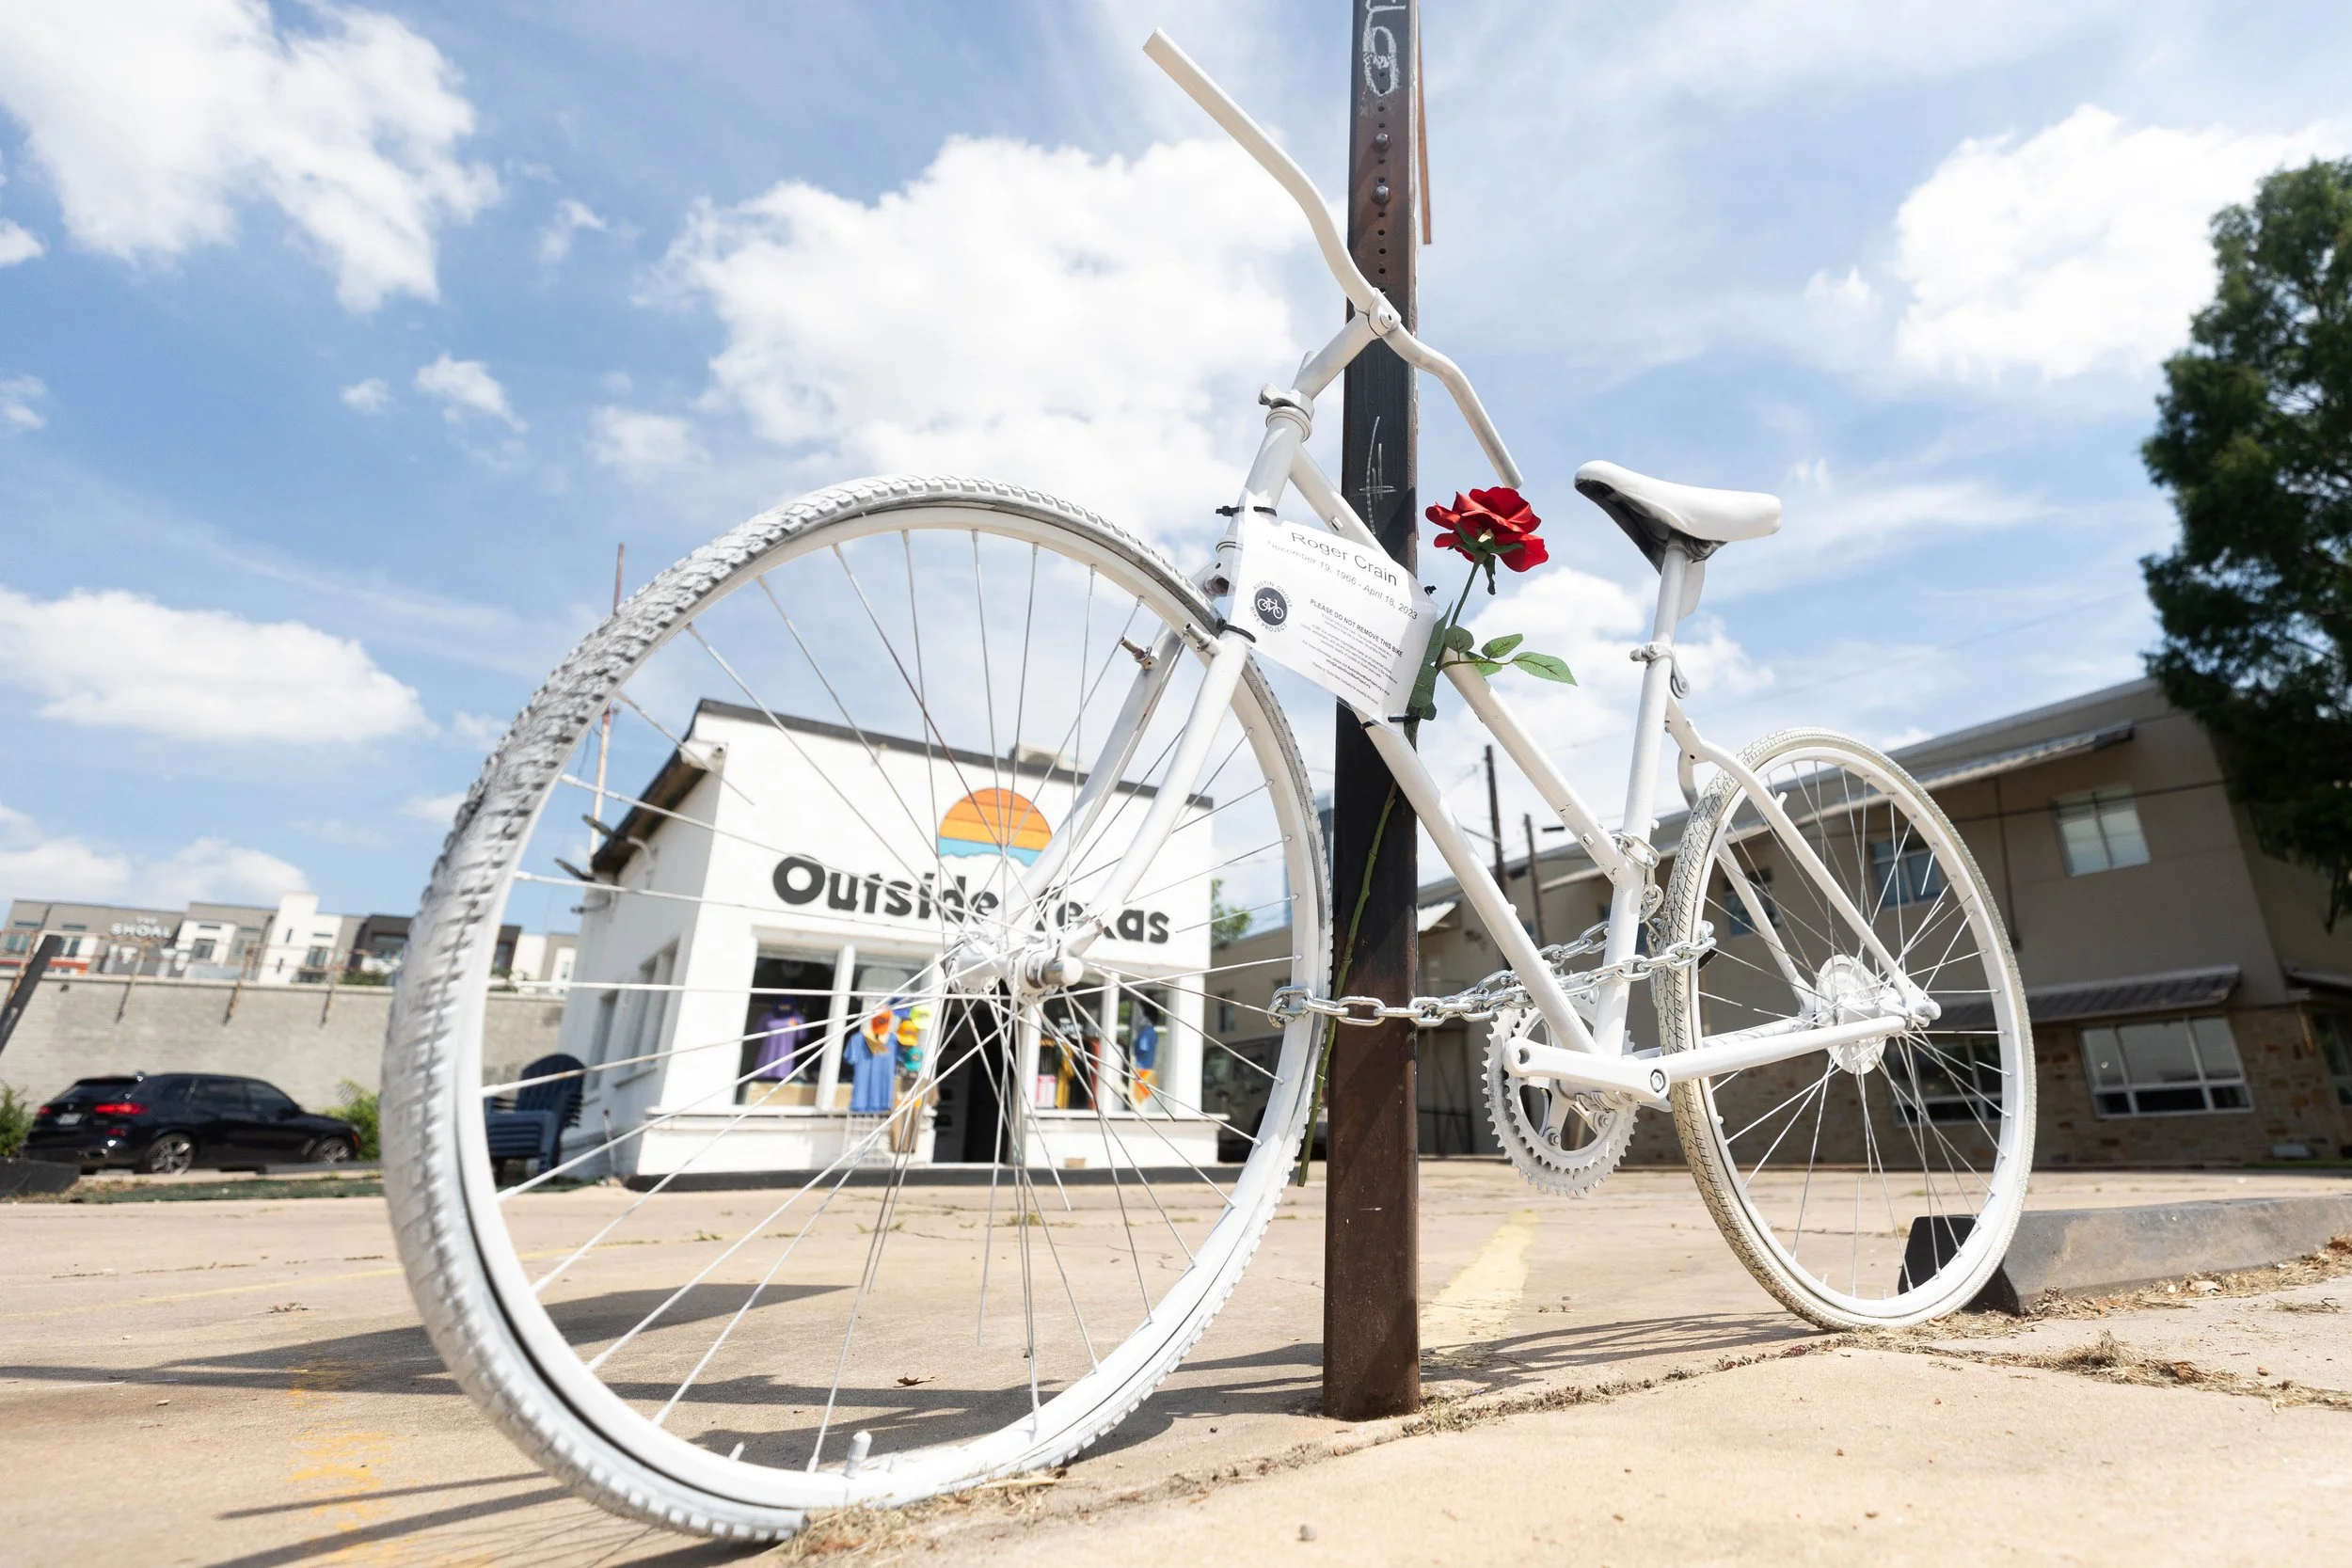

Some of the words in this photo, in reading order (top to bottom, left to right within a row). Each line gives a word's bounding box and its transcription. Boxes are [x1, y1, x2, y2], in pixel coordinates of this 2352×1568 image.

[1253, 580, 1275, 590] AUSTIN
[1292, 532, 1347, 560] Roger
[1355, 555, 1397, 586] Crain
[1337, 569, 1357, 585] 1966
[1363, 584, 1383, 600] April
[1398, 603, 1418, 620] 2023
[1261, 622, 1288, 633] PROJECT
[1310, 598, 1334, 616] PLEASE
[1334, 612, 1343, 621] DO
[1344, 617, 1356, 627] NOT
[1357, 624, 1380, 642] REMOVE
[1380, 639, 1391, 650] THIS
[1391, 646, 1404, 658] BIKE
[773, 855, 998, 925] Outside
